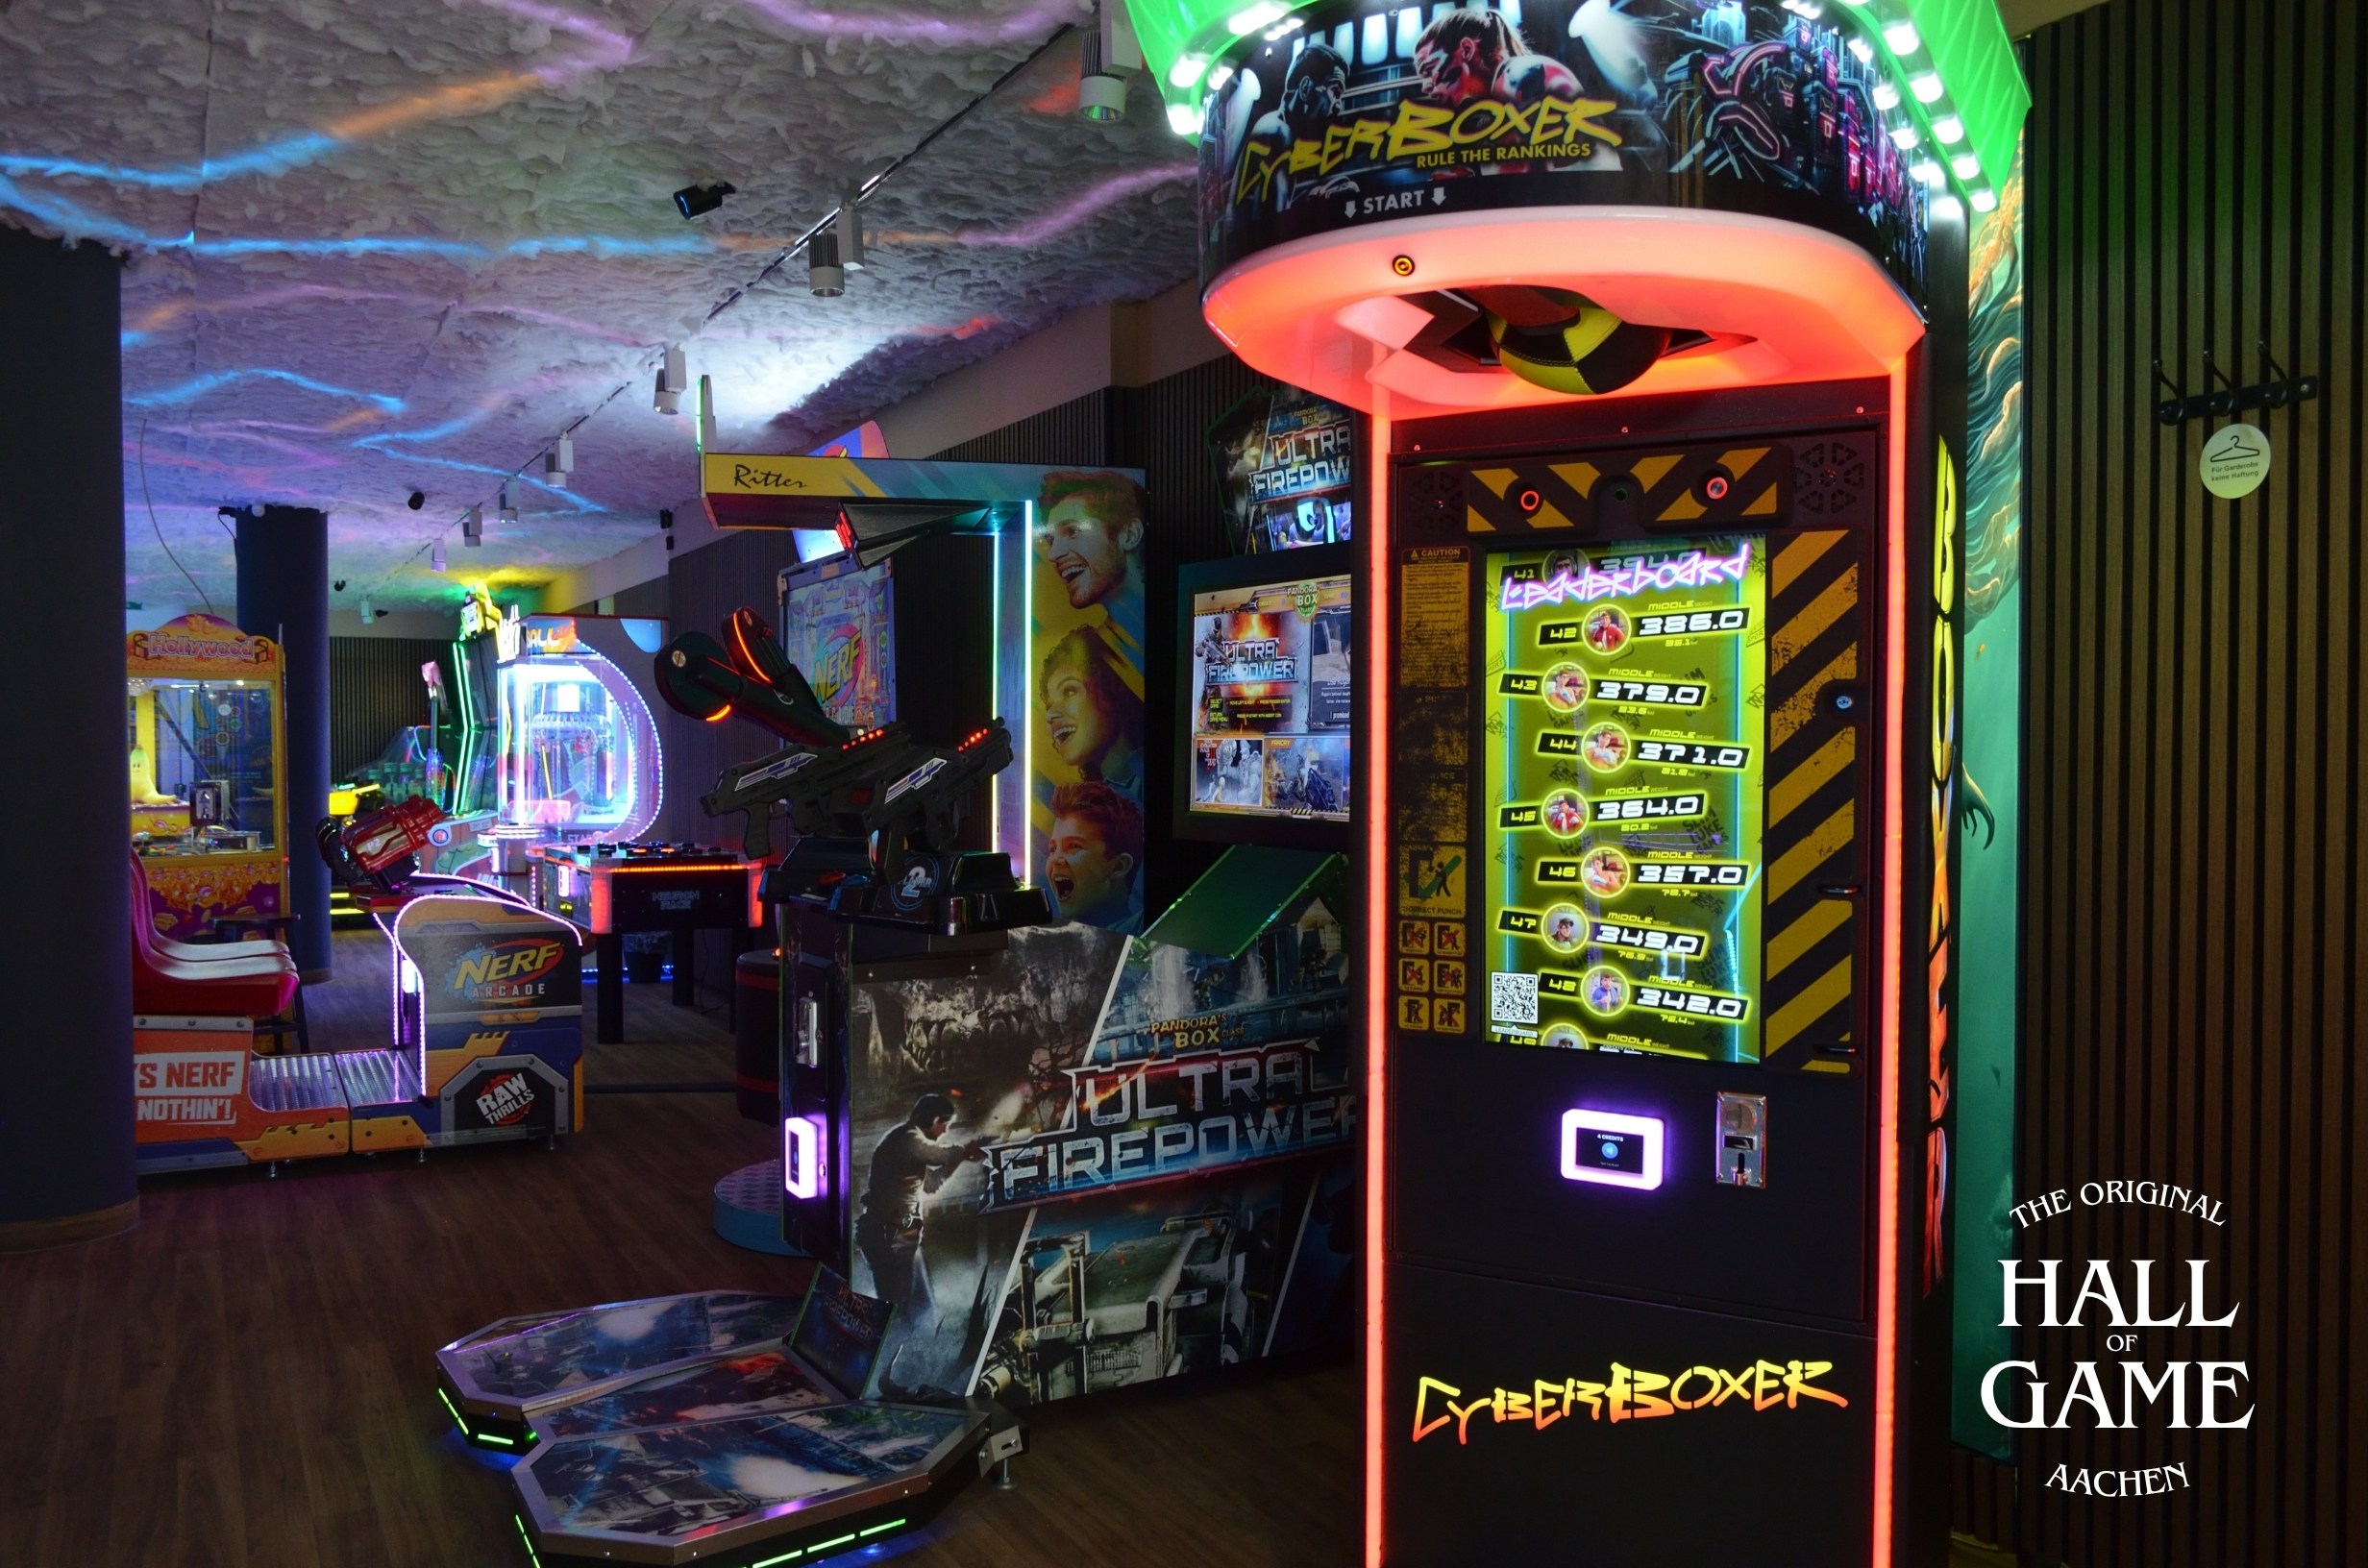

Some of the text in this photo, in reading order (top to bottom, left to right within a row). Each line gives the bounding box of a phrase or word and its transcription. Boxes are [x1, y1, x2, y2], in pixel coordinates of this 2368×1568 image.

[1417, 142, 1591, 169] RULE THE RANKINGS
[1363, 190, 1425, 214] START
[1275, 427, 1350, 465] ULTRA
[734, 464, 807, 488] Ritter
[2224, 461, 2258, 472] Garderobe
[2232, 470, 2258, 479] Haftung
[1421, 549, 1460, 557] CAUTION
[1514, 568, 1535, 579] 41
[1296, 593, 1319, 605] BOX
[1648, 600, 1694, 611] MIDDLE
[1549, 610, 1743, 639] 42 386.0
[149, 633, 254, 658] Hollywood
[1224, 641, 1276, 662] ULTRA
[813, 631, 862, 703] NERF
[1608, 668, 1654, 677] MIDDLE
[1510, 678, 1700, 703] 43 379.0
[1649, 728, 1695, 739] MIDDLE
[1549, 737, 1743, 766] 44 371.0
[1605, 785, 1650, 796] MIDDLE
[1510, 796, 1699, 821] 45 364.0
[366, 838, 382, 850] P2
[901, 866, 925, 897] 2
[1549, 865, 1743, 883] 46 357.0
[653, 891, 700, 901] NEURON
[661, 900, 691, 910] RACE
[1608, 912, 1653, 924] MIDDLE
[1510, 916, 1699, 952] 47 349.0
[454, 943, 562, 991] NERF
[472, 983, 545, 997] ARCADE
[1648, 975, 1694, 988] MIDDLE
[1548, 978, 1741, 1017] 48 342.0
[1151, 1014, 1227, 1035] PANDORA'S
[1494, 1027, 1534, 1036] LEADERBOARD
[1174, 1027, 1245, 1049] BOX CLASS
[1606, 1033, 1652, 1046] MIDDLE
[165, 1062, 235, 1089] NERF
[476, 1072, 529, 1115] RAW
[1086, 1051, 1303, 1127] ULTRA
[137, 1099, 232, 1120] NOTHIN'!
[484, 1089, 535, 1125] THRILLS
[1601, 1134, 1624, 1142] CREDITS
